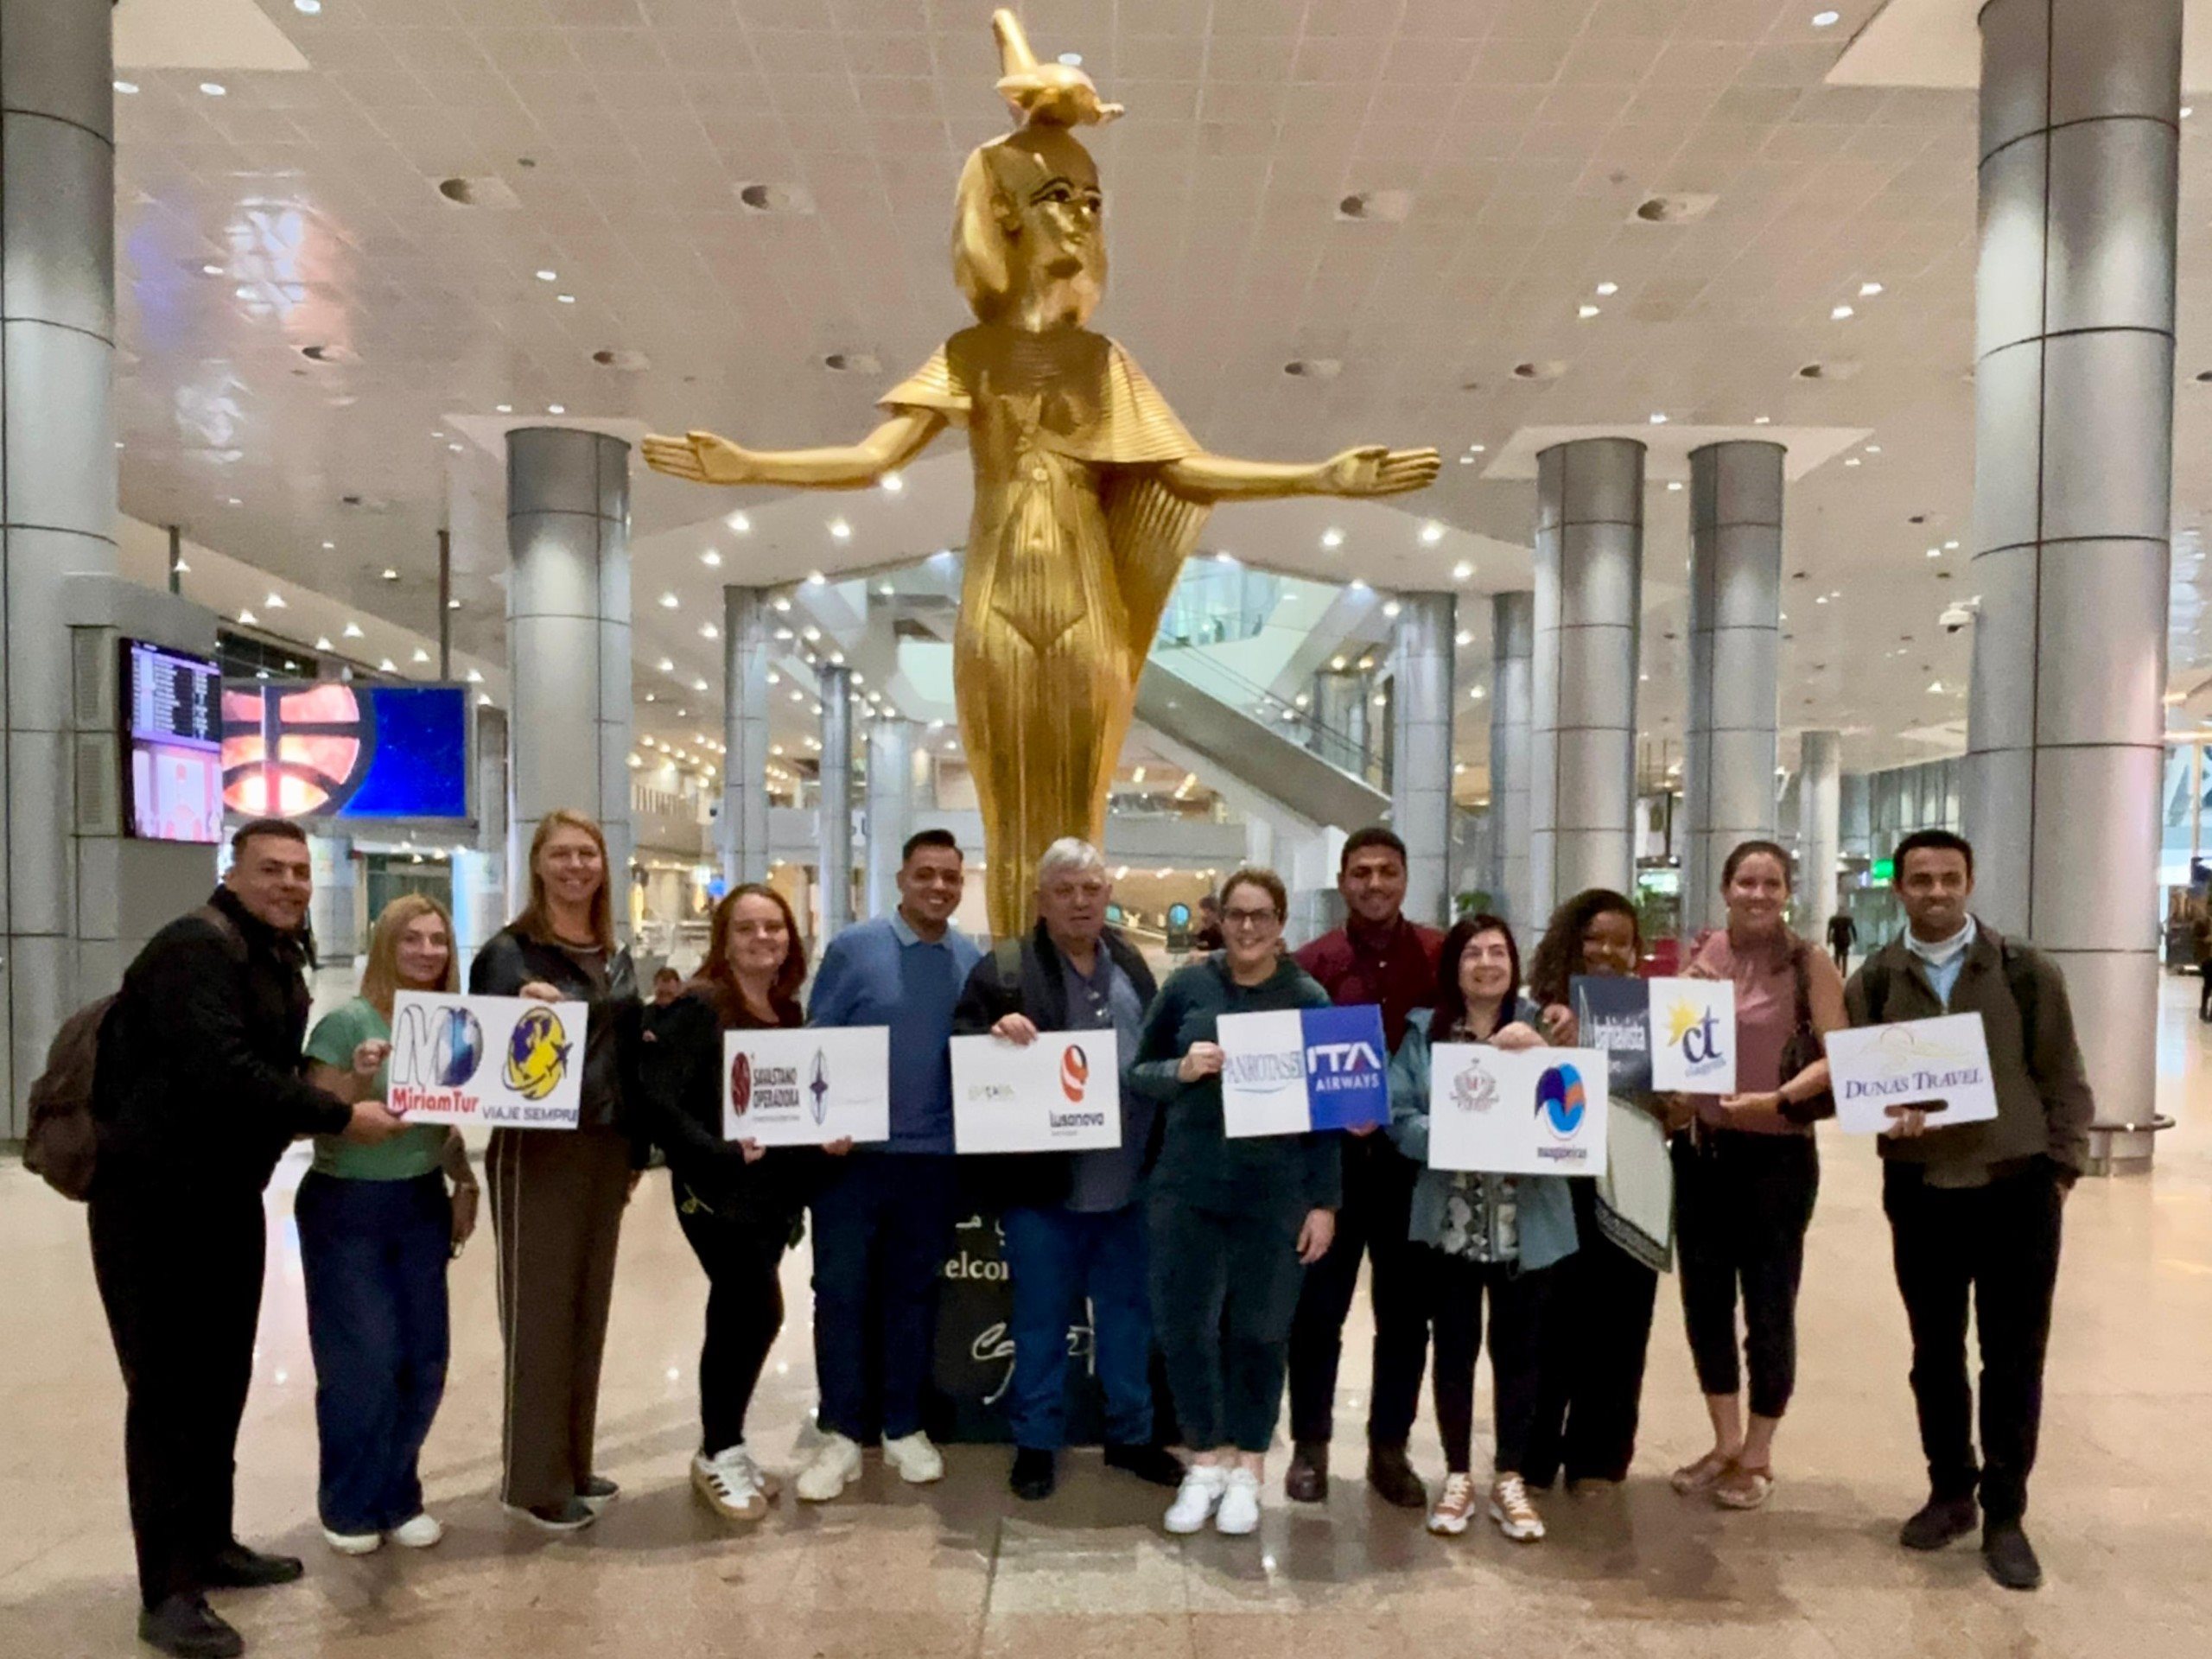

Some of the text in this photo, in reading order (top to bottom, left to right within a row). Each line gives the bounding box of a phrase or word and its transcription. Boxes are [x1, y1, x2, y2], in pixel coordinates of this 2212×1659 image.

[1306, 1041, 1382, 1074] ITA
[1315, 1073, 1380, 1092] AIRWAYS
[1846, 1068, 1983, 1099] DUNAS TRAVEL
[391, 1087, 480, 1114] MiriamTur
[482, 1106, 519, 1121] VIAJE
[1049, 1110, 1104, 1128] lusanova
[945, 1251, 1010, 1281] elco
